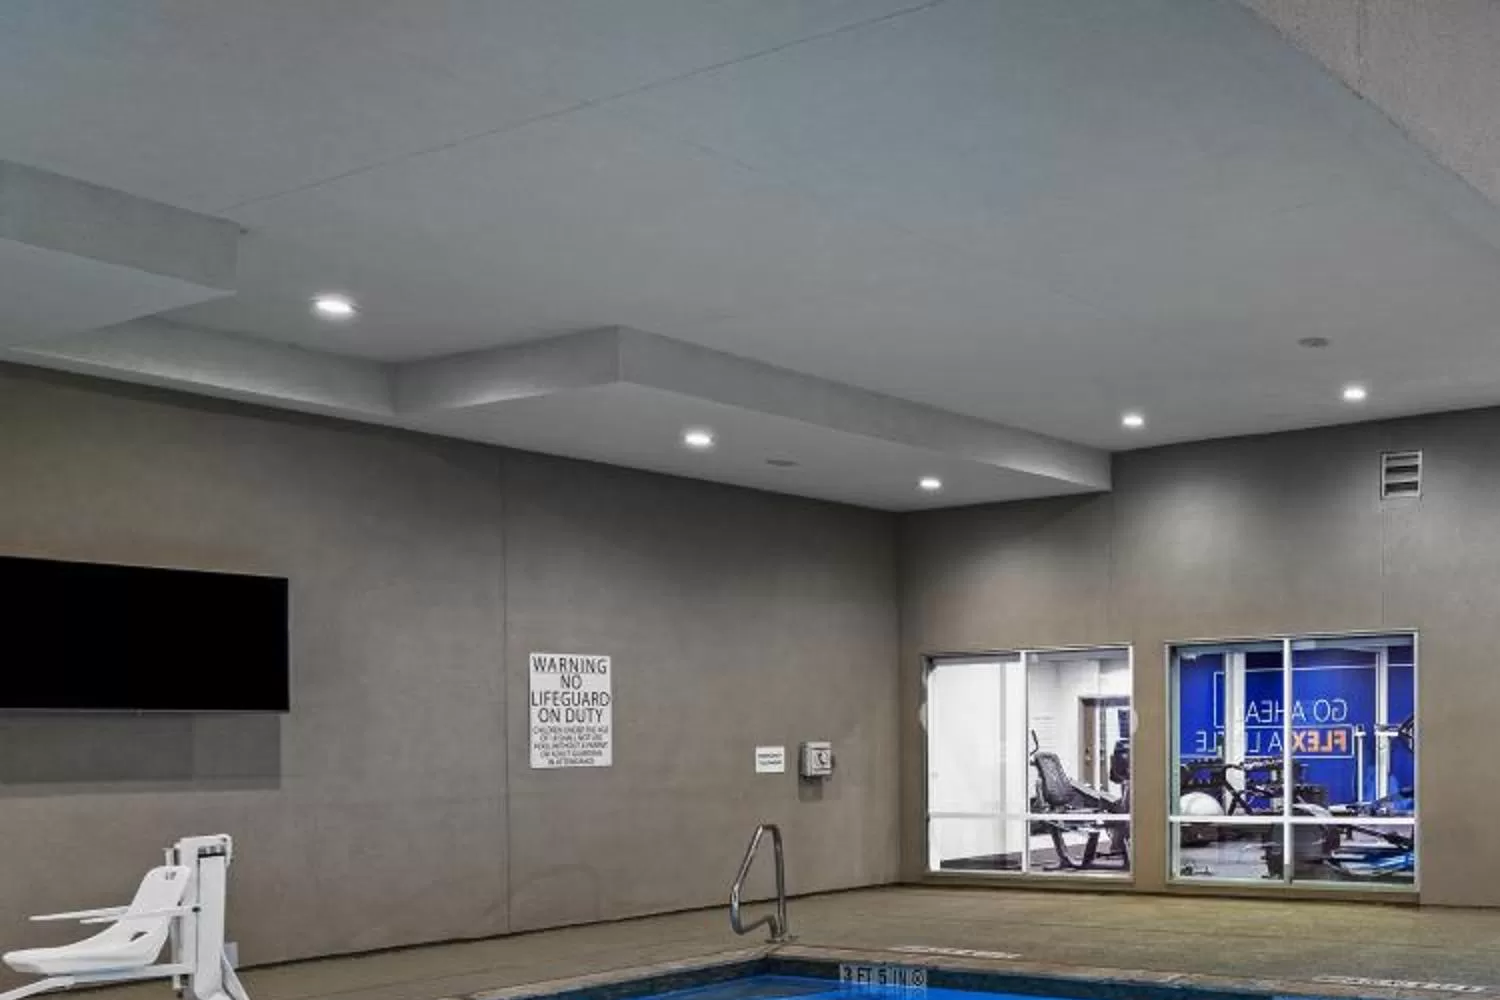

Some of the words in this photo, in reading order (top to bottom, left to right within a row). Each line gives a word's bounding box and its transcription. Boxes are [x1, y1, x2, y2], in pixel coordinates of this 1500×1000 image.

[532, 656, 608, 674] WARNING
[560, 674, 583, 690] NO
[531, 691, 610, 707] LIFEGUARD
[538, 707, 561, 723] ON
[565, 707, 604, 723] DUTY
